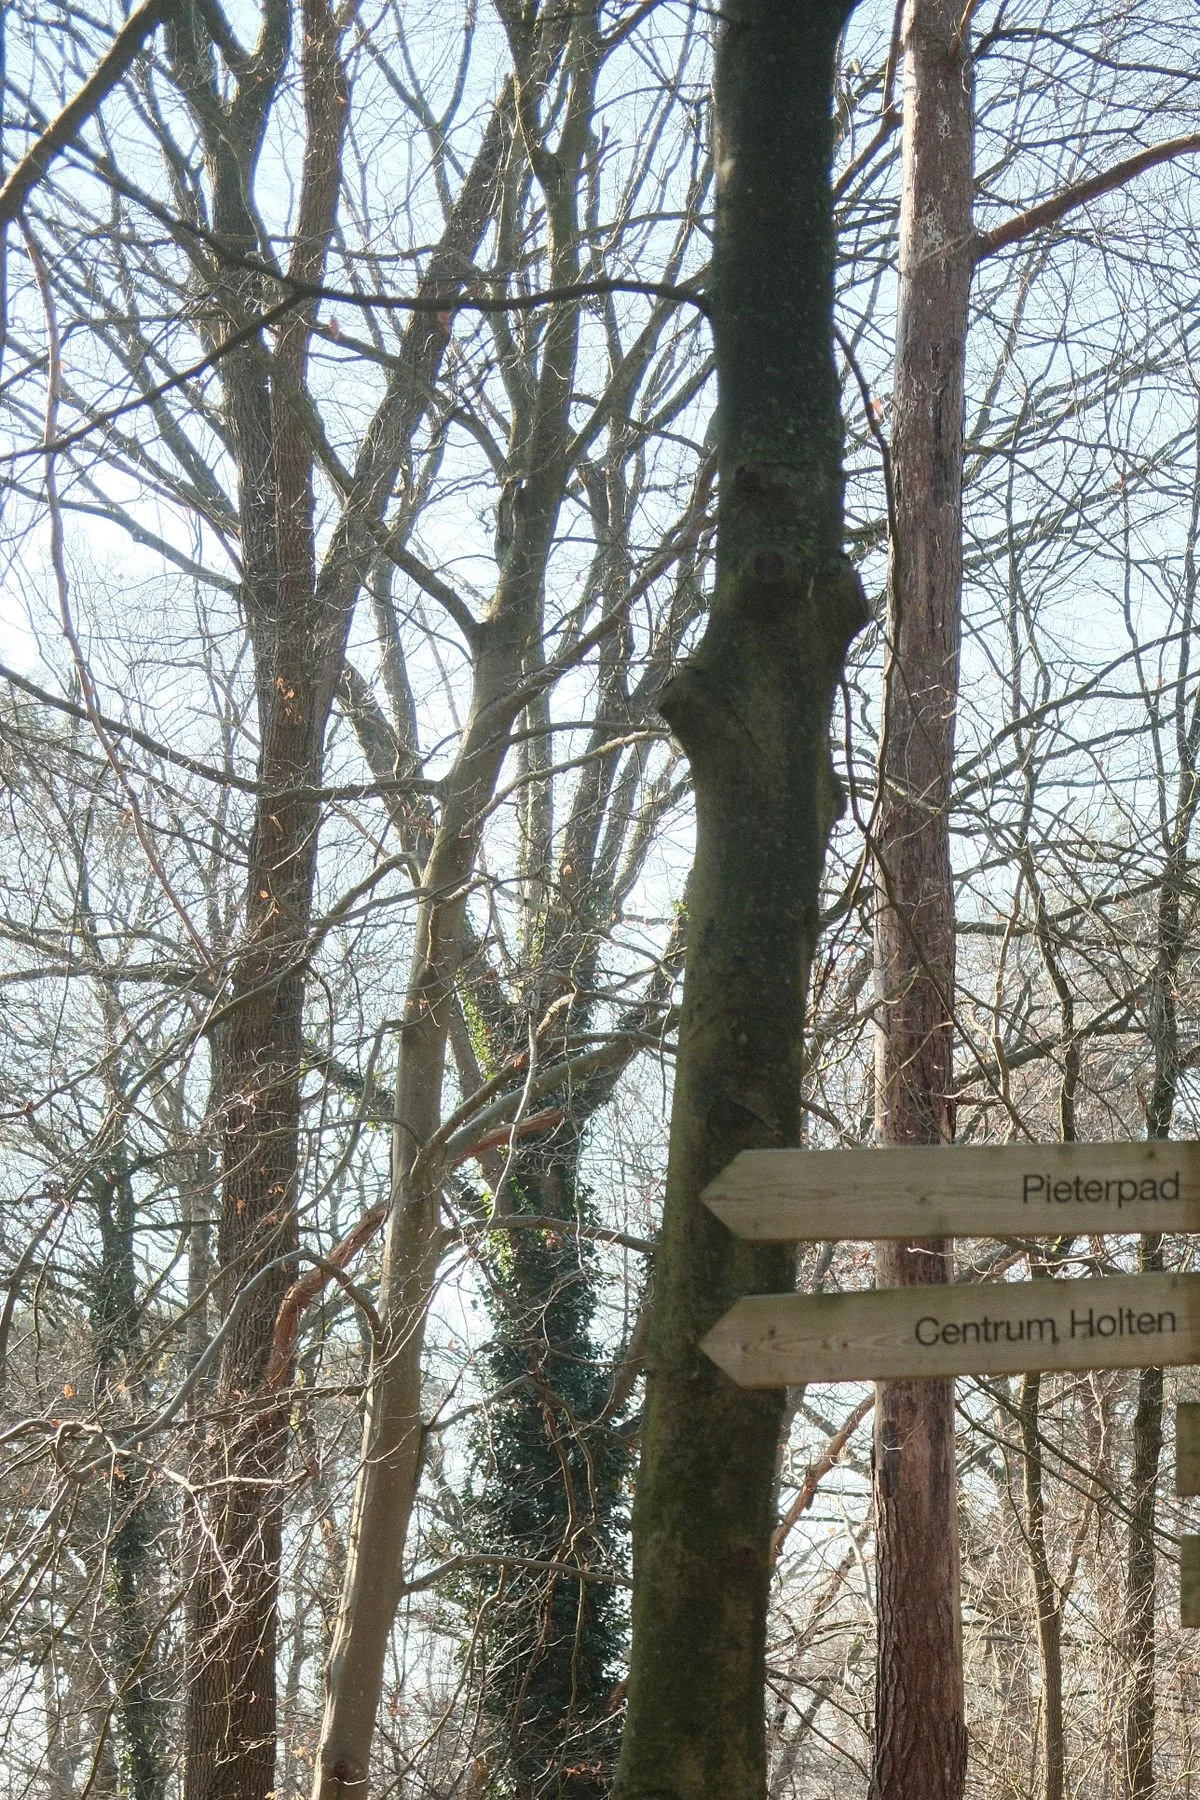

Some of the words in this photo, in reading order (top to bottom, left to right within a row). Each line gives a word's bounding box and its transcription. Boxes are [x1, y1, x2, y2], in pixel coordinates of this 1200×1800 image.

[1021, 1171, 1181, 1208] Pieterpad
[914, 1313, 1056, 1347] Centrum
[1069, 1306, 1178, 1339] Holten
